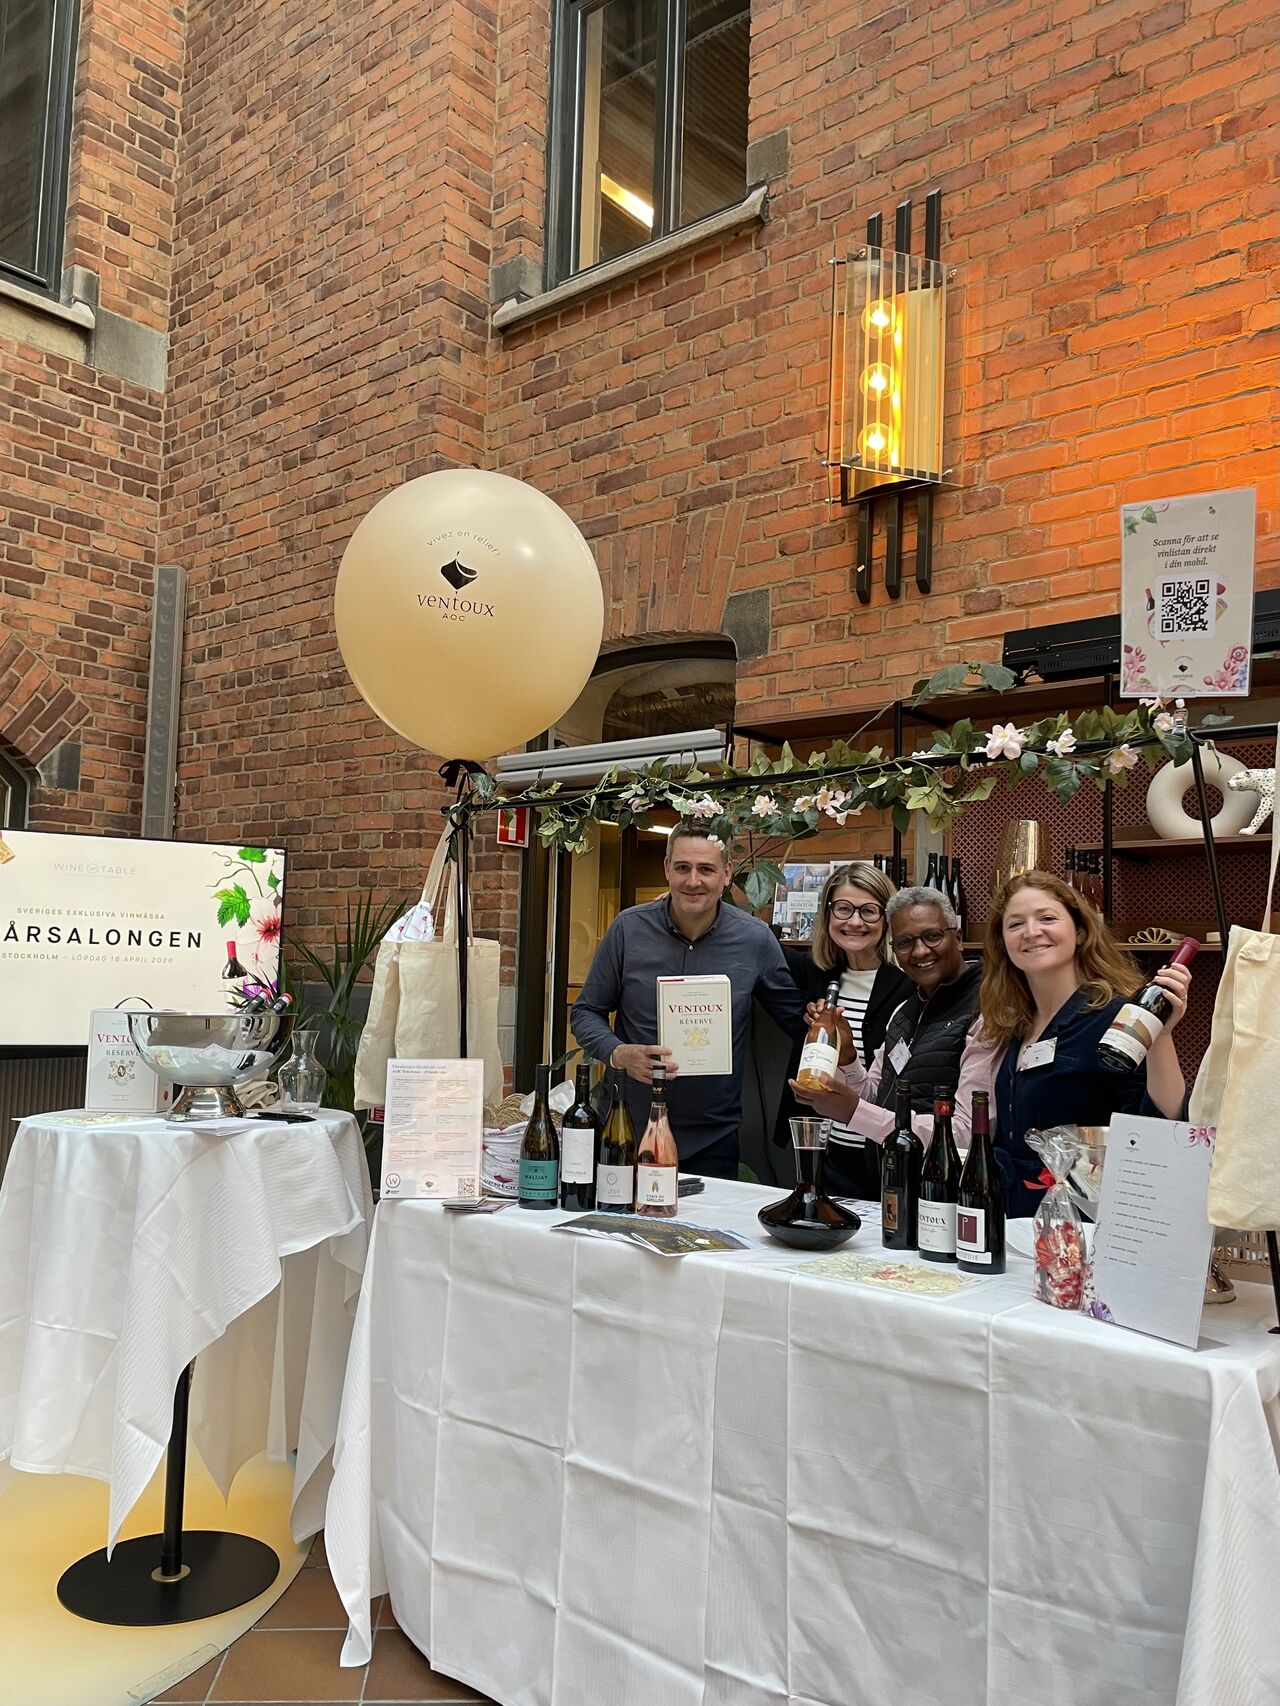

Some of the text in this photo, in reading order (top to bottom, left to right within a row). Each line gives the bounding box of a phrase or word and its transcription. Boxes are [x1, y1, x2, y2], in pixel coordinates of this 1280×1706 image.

[1153, 538, 1182, 547] Scanna
[1182, 535, 1196, 546] för
[1196, 534, 1209, 542] att
[1157, 545, 1216, 557] vinlistan direkt
[1169, 560, 1182, 568] din
[1184, 557, 1208, 566] mobil.
[442, 612, 466, 622] AOC
[54, 863, 85, 873] WINE
[101, 865, 137, 875] TABLE
[17, 907, 62, 915] SVERIGES
[66, 909, 116, 918] EXKLUSIVA
[3, 920, 201, 948] ÅRSALONGEN
[2, 952, 59, 960] STOCKHOLM
[668, 1004, 724, 1013] VENTOUX
[97, 1033, 133, 1044] VENTO
